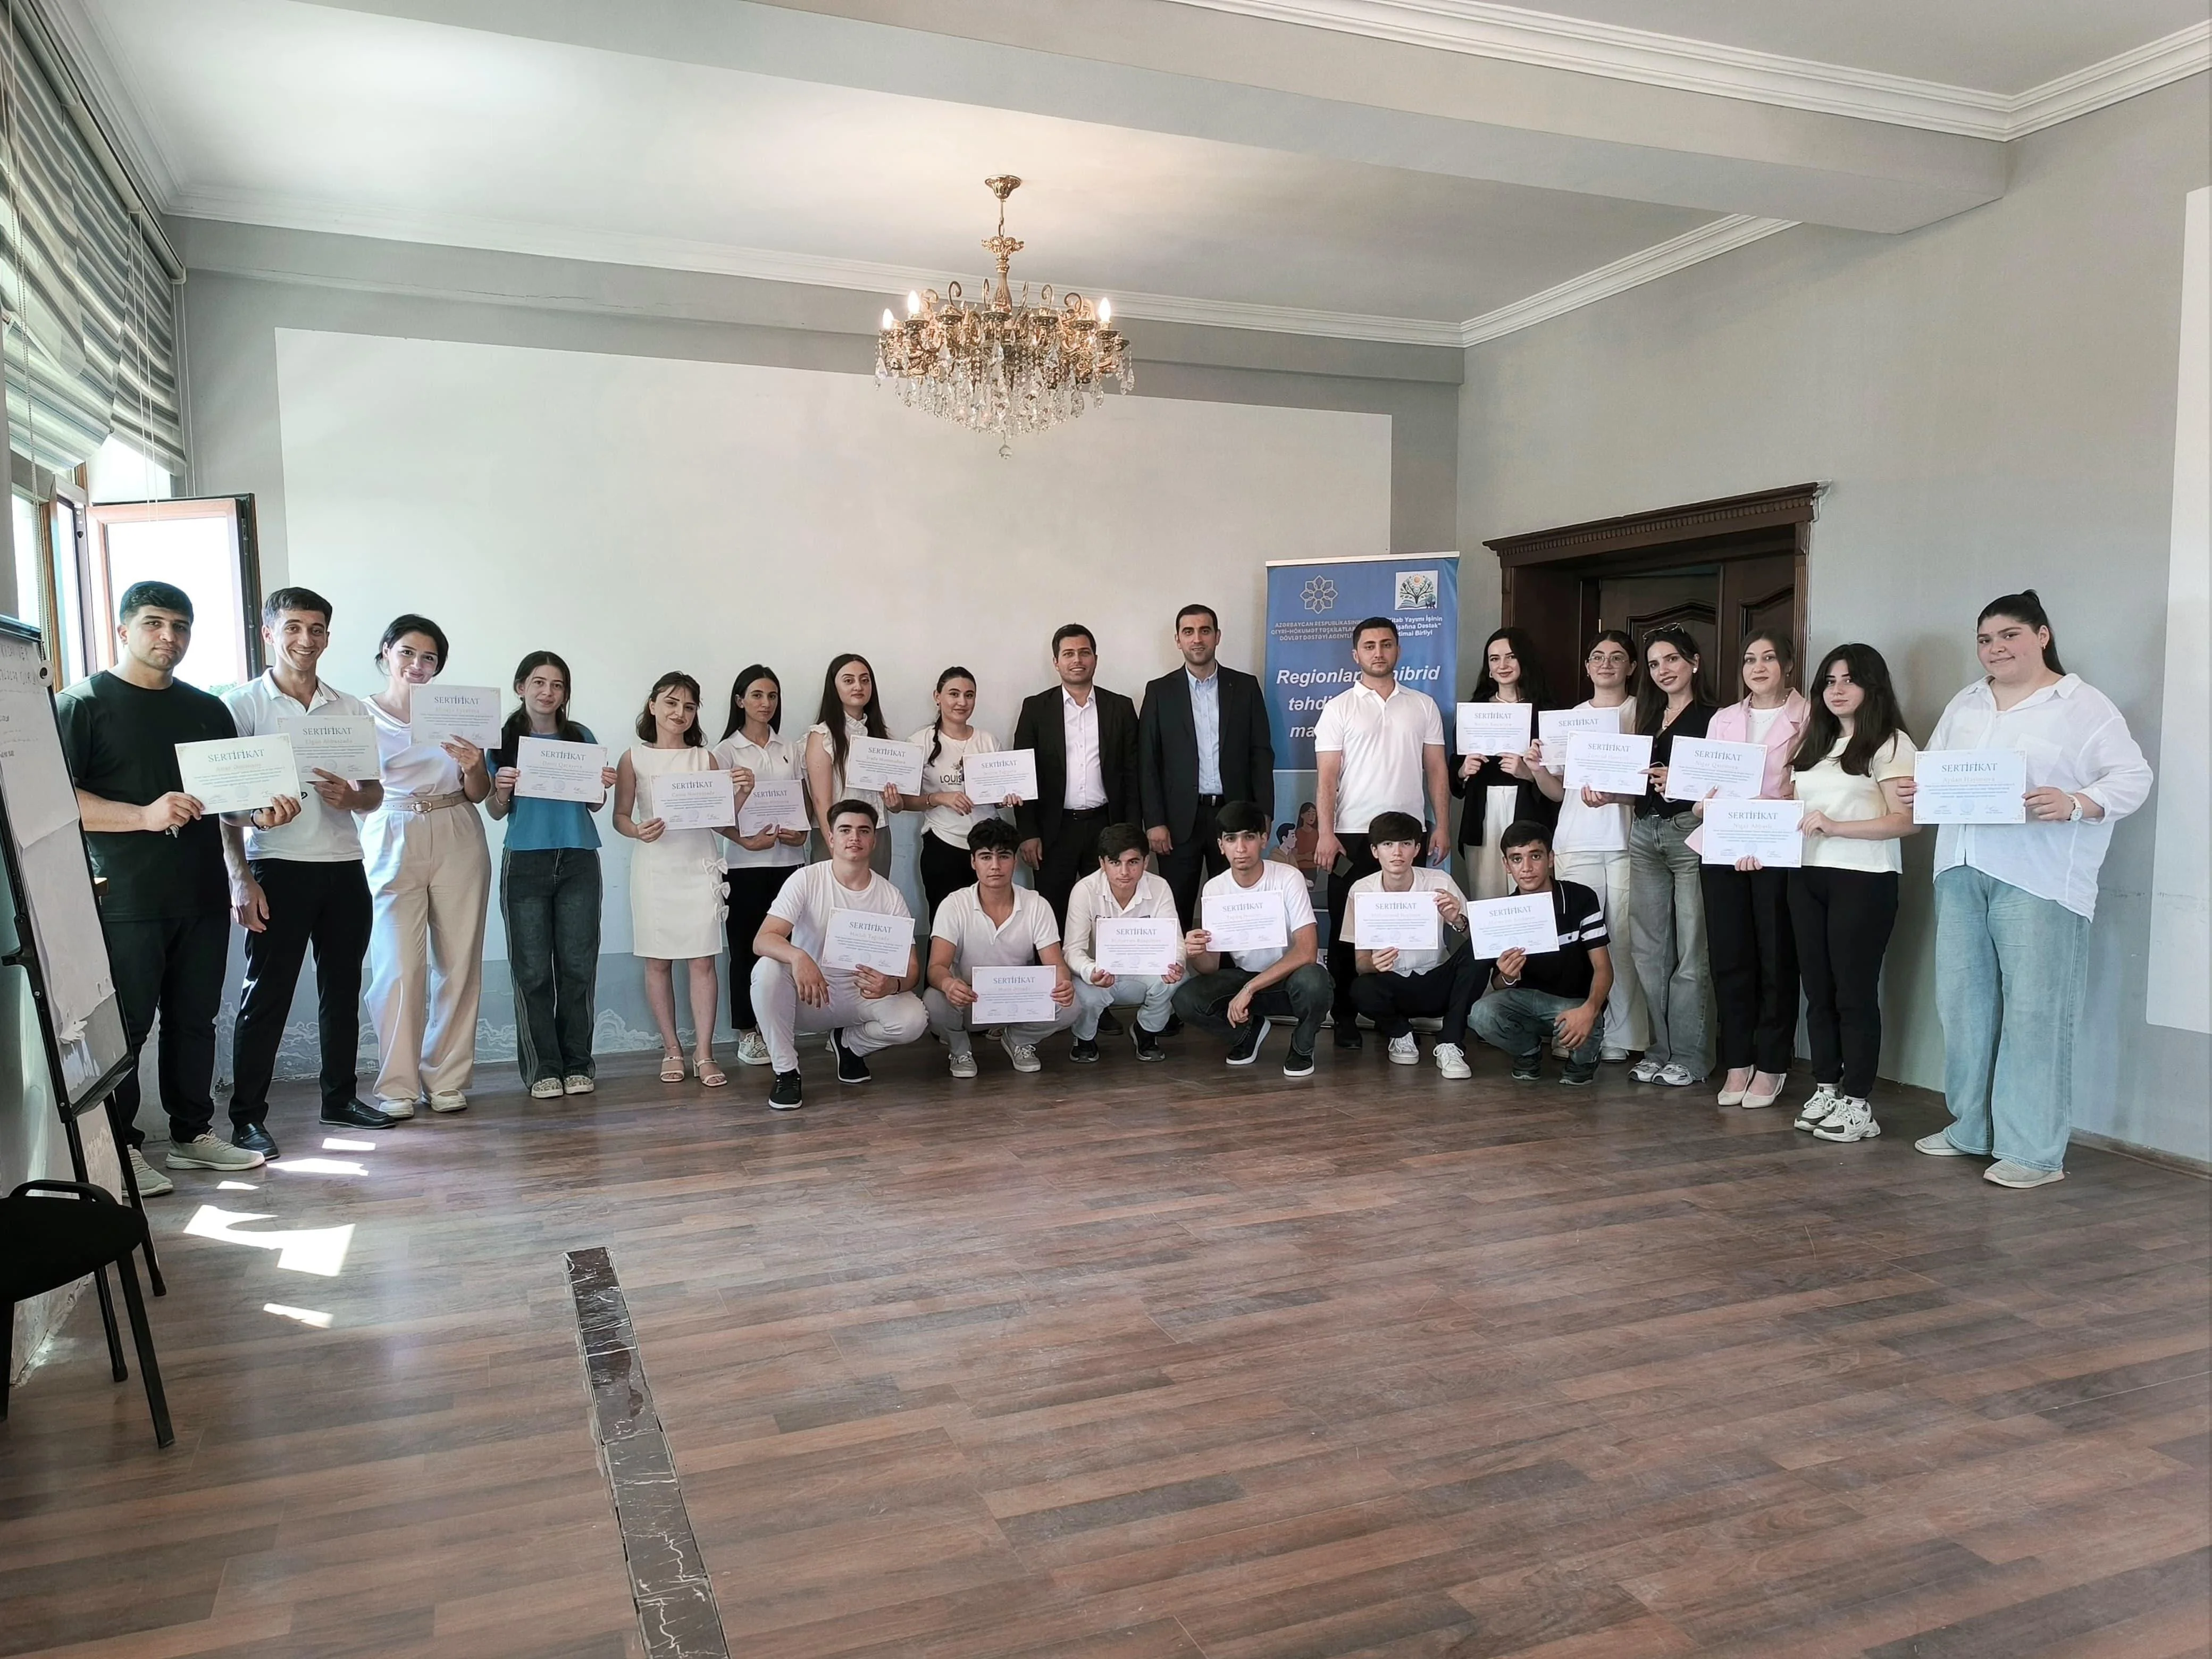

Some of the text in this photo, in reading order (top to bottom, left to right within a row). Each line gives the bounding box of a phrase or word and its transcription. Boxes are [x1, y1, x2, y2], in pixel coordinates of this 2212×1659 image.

[1276, 668, 1362, 688] Regionlar
[434, 696, 481, 705] SERTİFİKAT
[1558, 718, 1599, 727] SERTİFİKAT
[303, 726, 353, 735] SERTİFİKAT
[868, 747, 906, 757] SERTİFİKAT
[1588, 743, 1631, 752] SERTİFİKAT
[208, 748, 264, 762] SERTİFİKAT
[540, 750, 586, 760] SERTİFİKAT
[1694, 749, 1742, 761] SERTİFİKAT
[981, 760, 1017, 768] SERTİFİKAT
[1941, 762, 1998, 772] SERTİFİKAT
[672, 781, 713, 790] SERTİFİKAT
[1728, 810, 1778, 819] SERTİFİKAT
[1222, 902, 1263, 912] SERTİFİKAT
[1489, 906, 1531, 917] SERTİFİKAT
[849, 921, 892, 933] SERTİFİKAT
